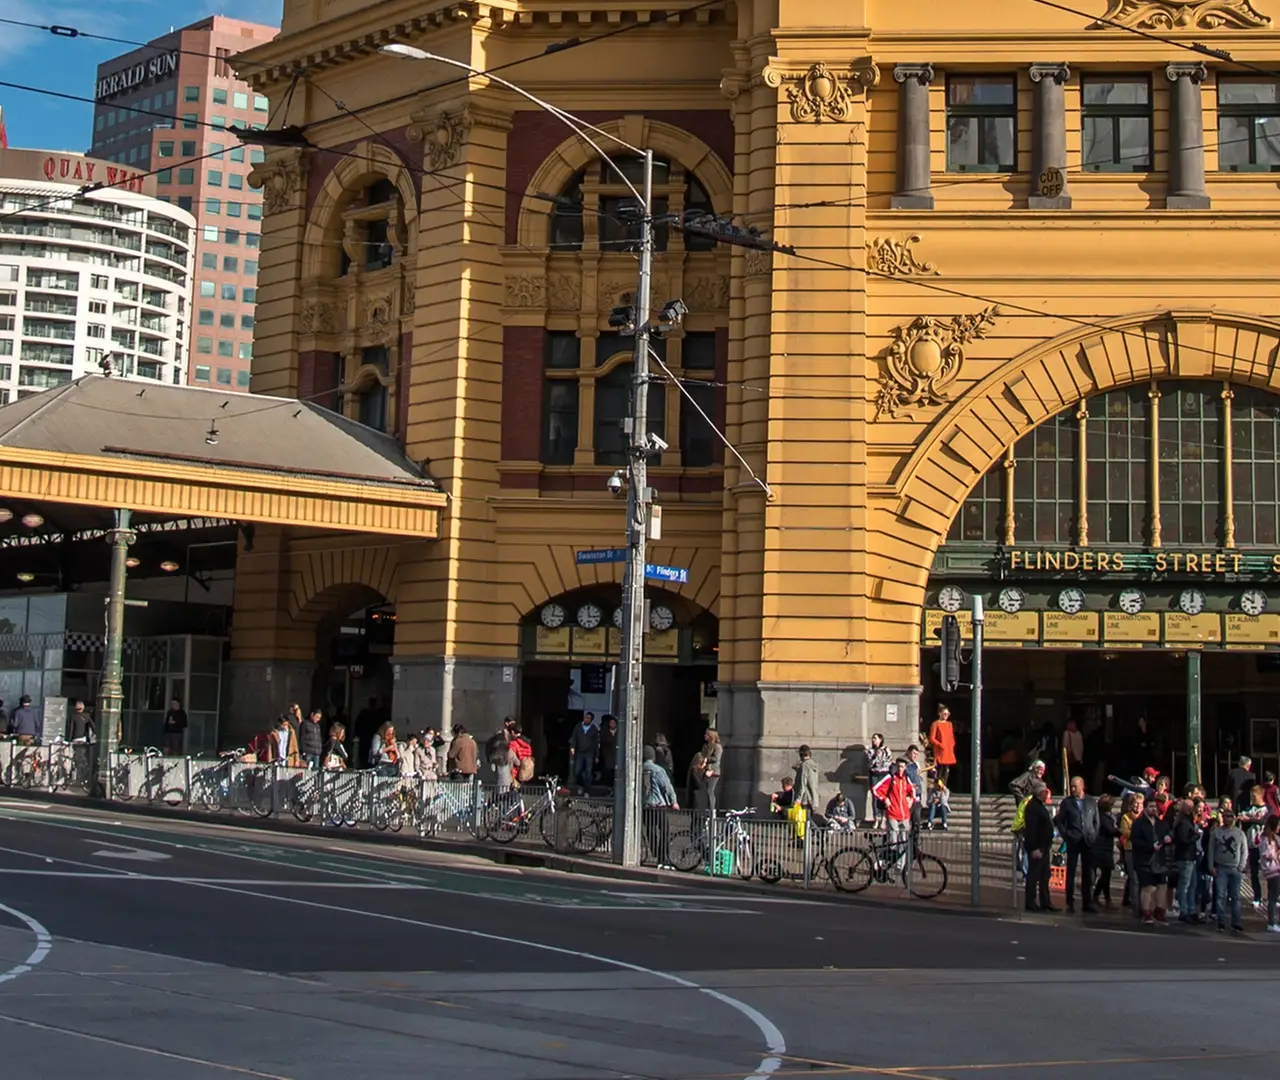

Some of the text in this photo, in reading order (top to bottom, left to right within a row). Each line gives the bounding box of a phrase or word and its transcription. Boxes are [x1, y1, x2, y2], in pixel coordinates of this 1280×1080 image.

[96, 52, 178, 98] HERALD SUN
[43, 157, 144, 193] QUAY WEST
[1040, 172, 1059, 183] CUT
[1042, 184, 1061, 196] OFF
[578, 552, 606, 560] Swanston
[1010, 551, 1124, 571] FLINDERS
[1155, 553, 1243, 573] STREET
[656, 566, 678, 576] Flinders
[984, 612, 1019, 620] FRANKSTON
[1046, 613, 1089, 621] SANDRINGHAM
[1168, 614, 1191, 622] ALTONA
[1238, 615, 1260, 623] ALBANS
